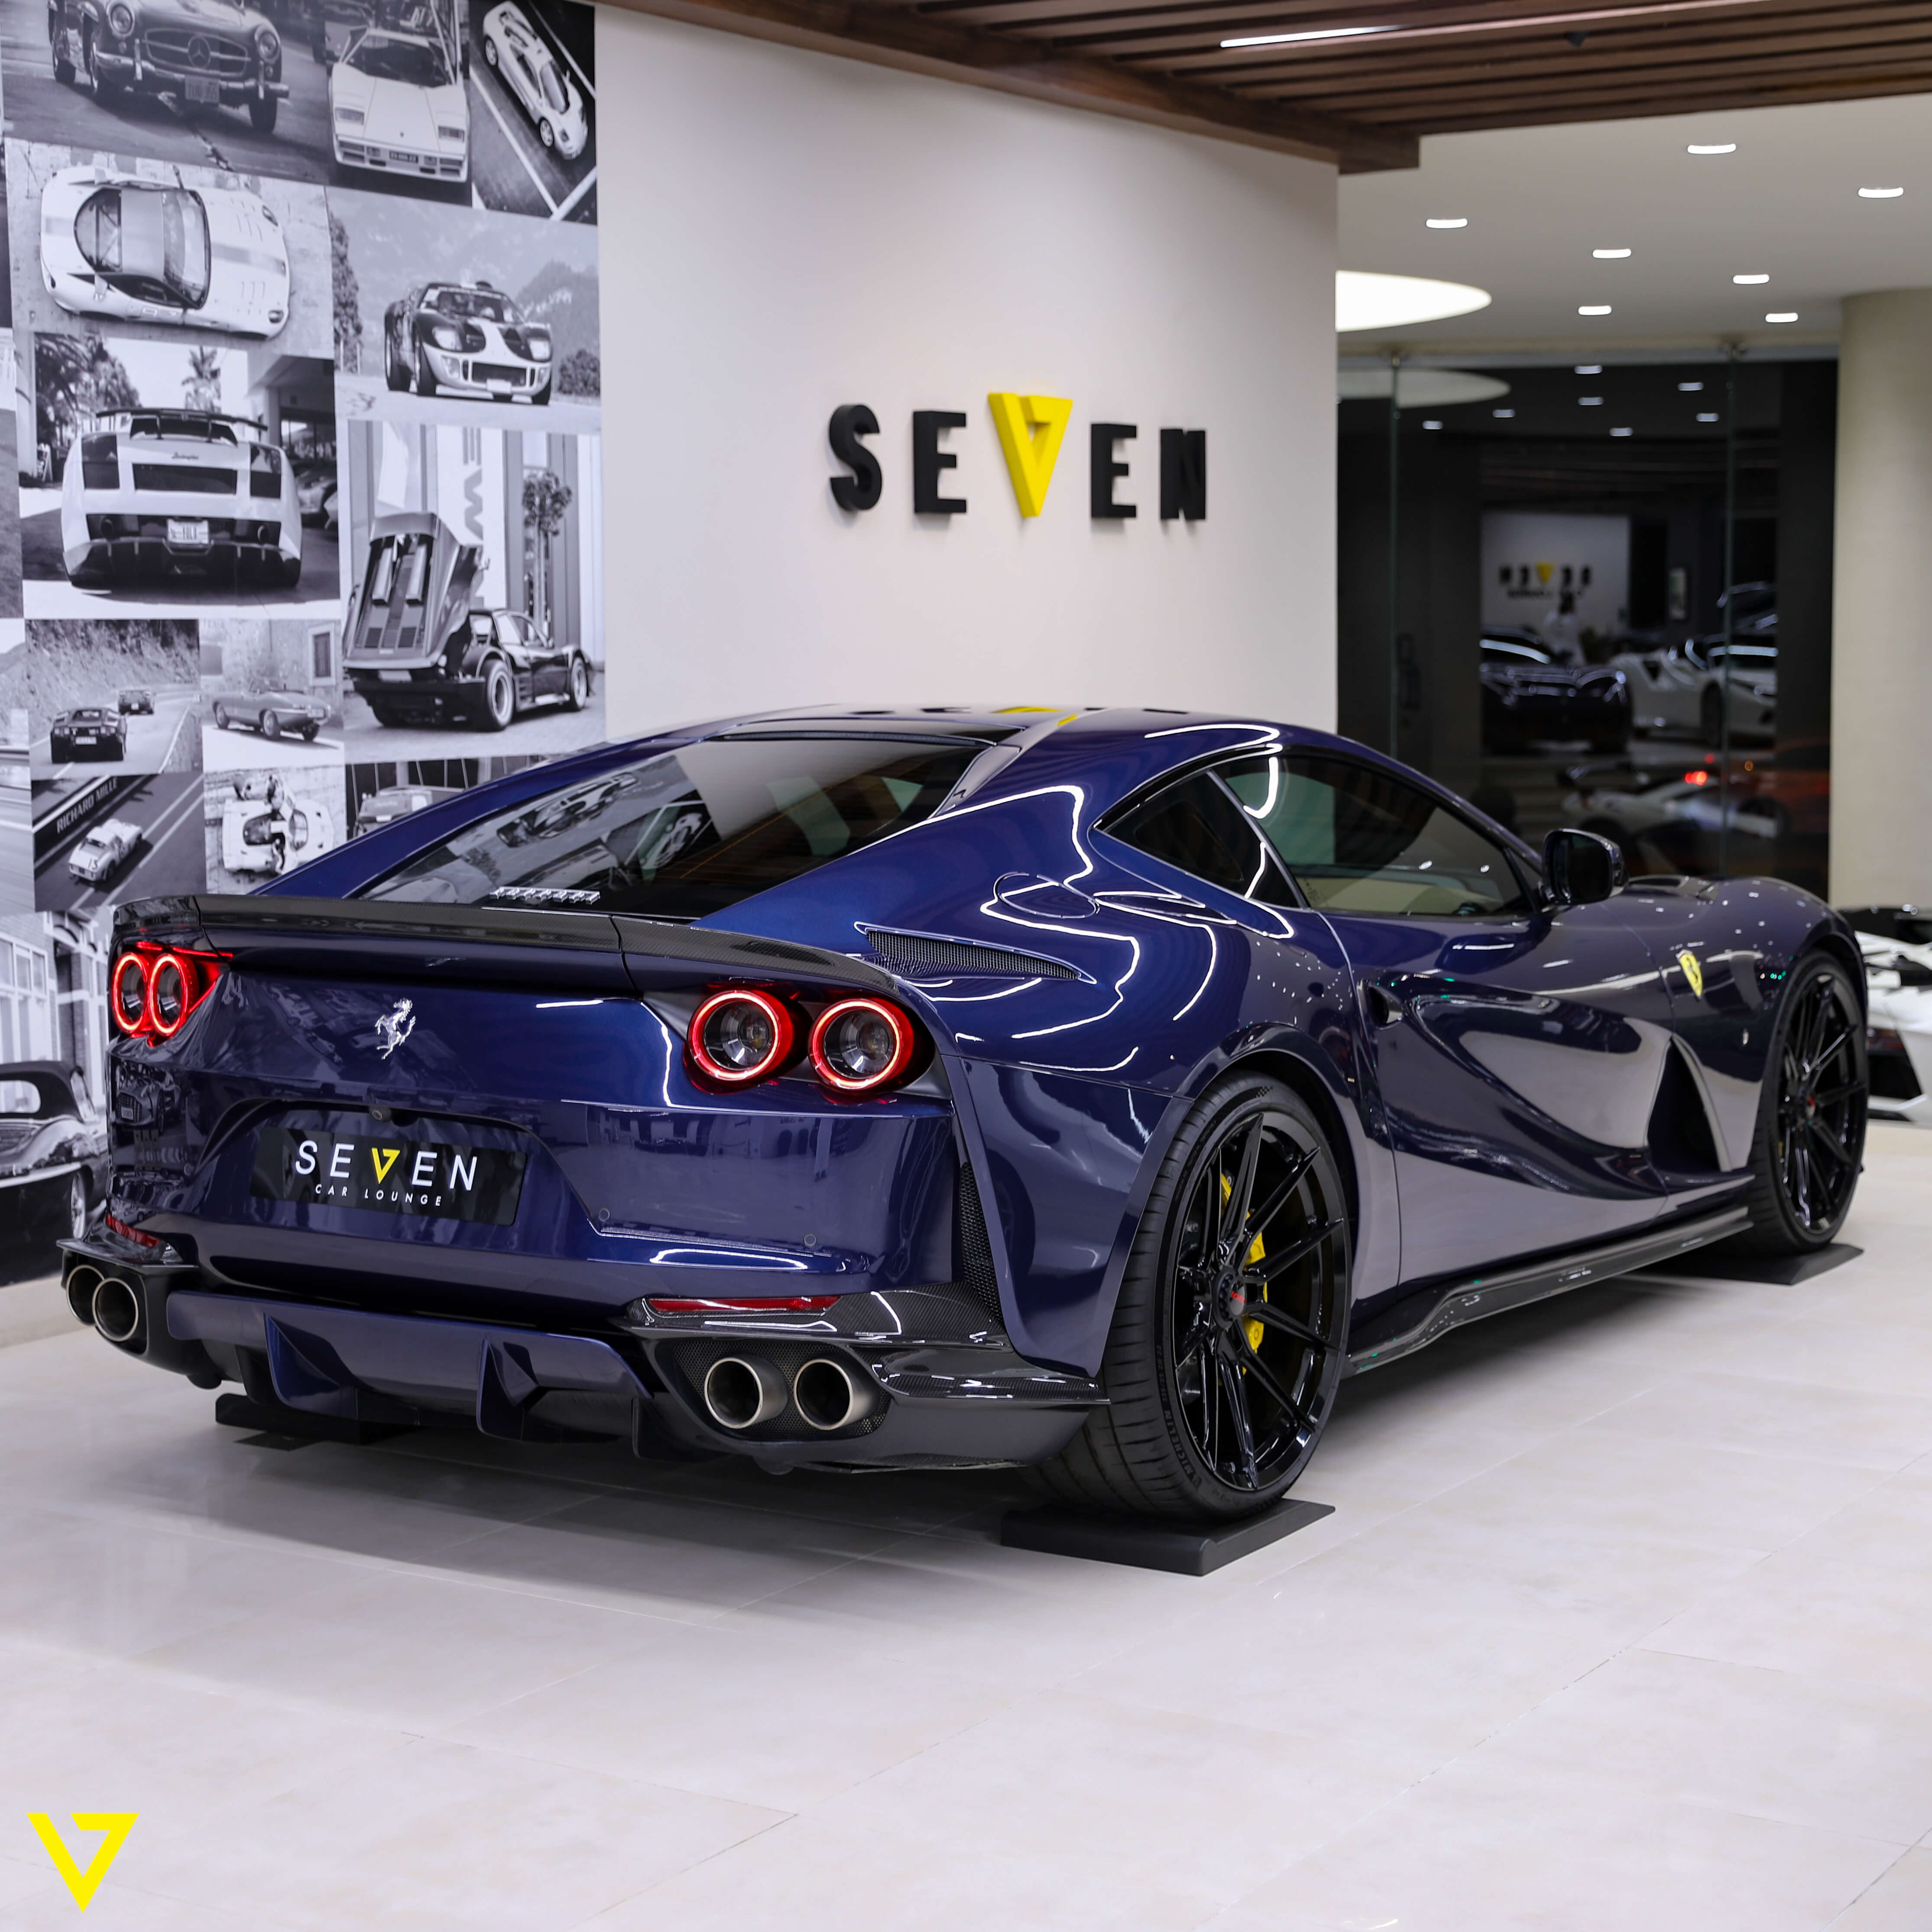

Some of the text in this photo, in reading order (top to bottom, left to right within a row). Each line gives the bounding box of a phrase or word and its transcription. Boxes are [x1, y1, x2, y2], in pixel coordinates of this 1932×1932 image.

[828, 392, 1206, 520] SEVEN
[56, 794, 94, 834] RICHARD
[295, 1140, 477, 1191] SEVEN
[315, 1183, 442, 1206] CAR LOUNGE
[1164, 1410, 1193, 1475] MICHELIN
